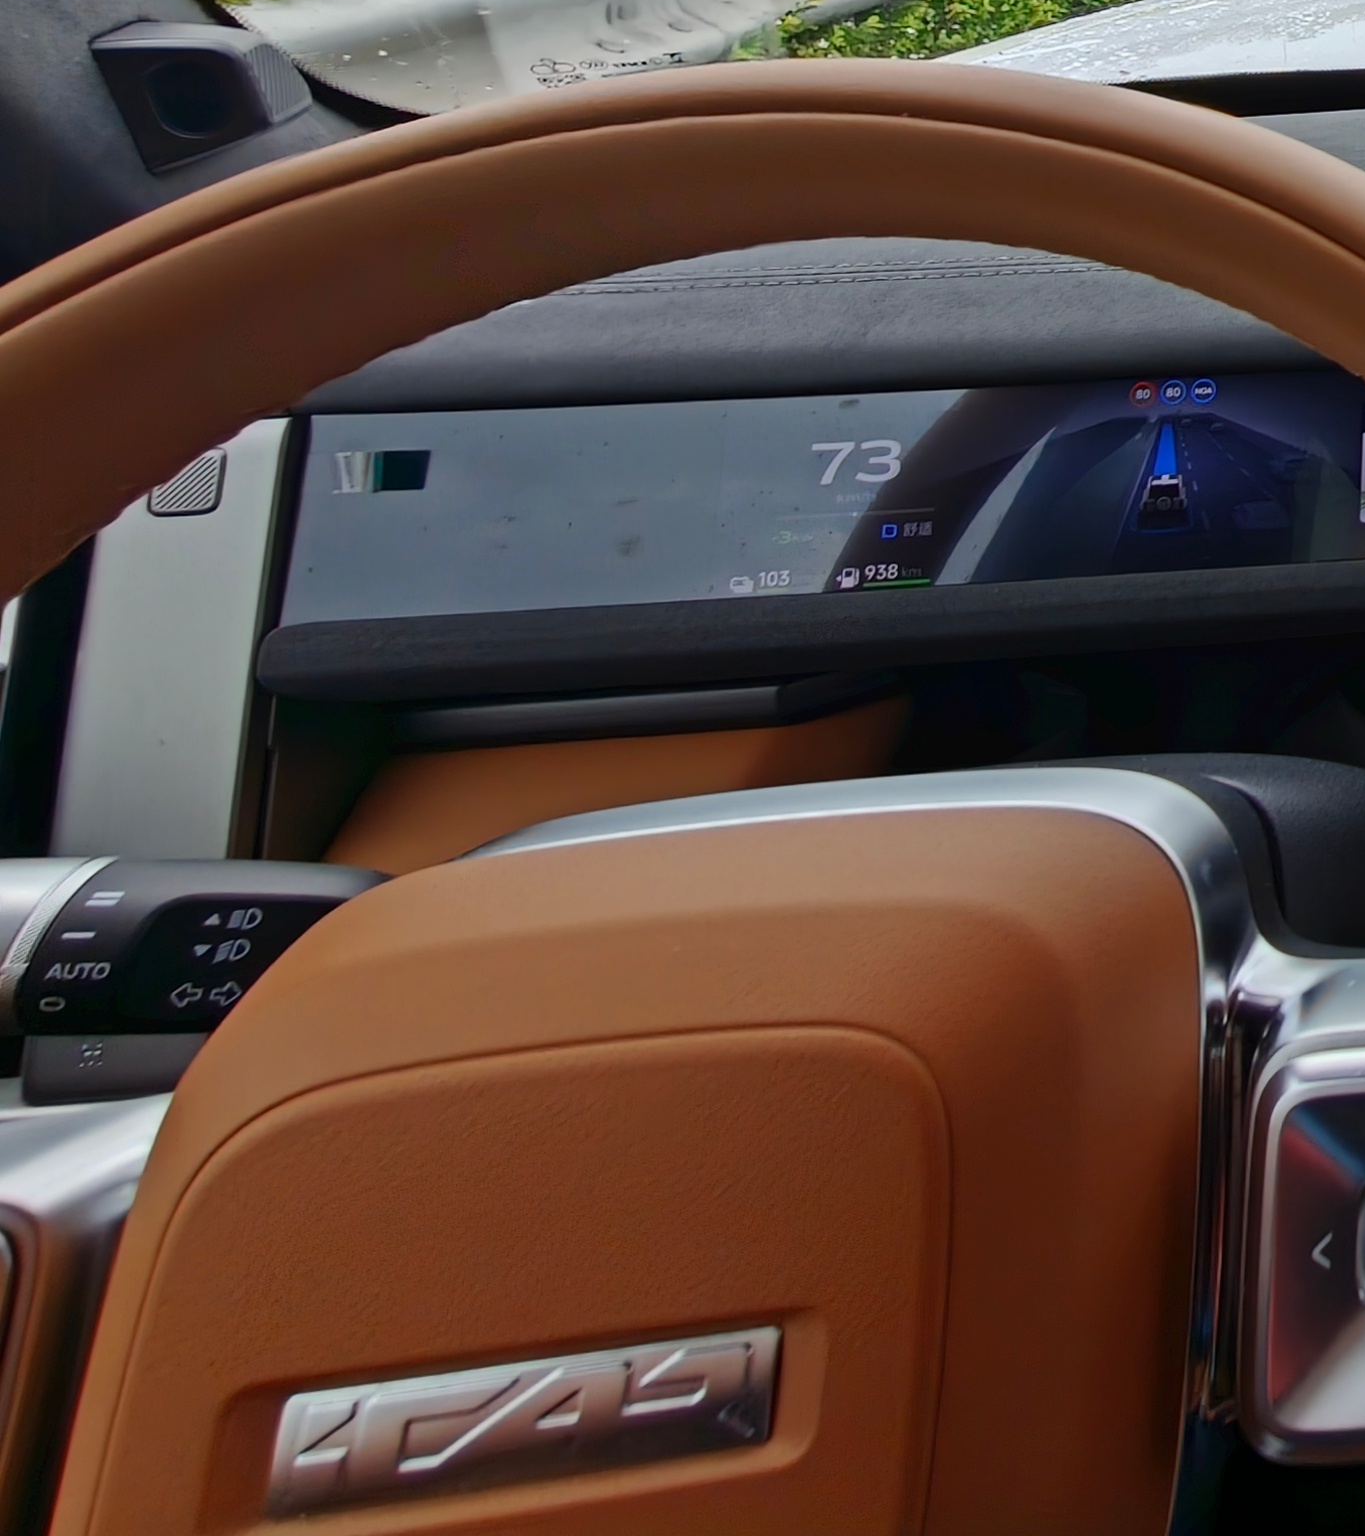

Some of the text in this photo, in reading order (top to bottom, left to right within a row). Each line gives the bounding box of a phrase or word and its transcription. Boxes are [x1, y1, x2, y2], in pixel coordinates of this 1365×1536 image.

[1135, 388, 1151, 400] 80
[1165, 386, 1181, 398] 80
[810, 439, 902, 485] 73
[758, 570, 791, 587] 103
[864, 563, 899, 581] 938
[44, 962, 112, 980] AUTO
